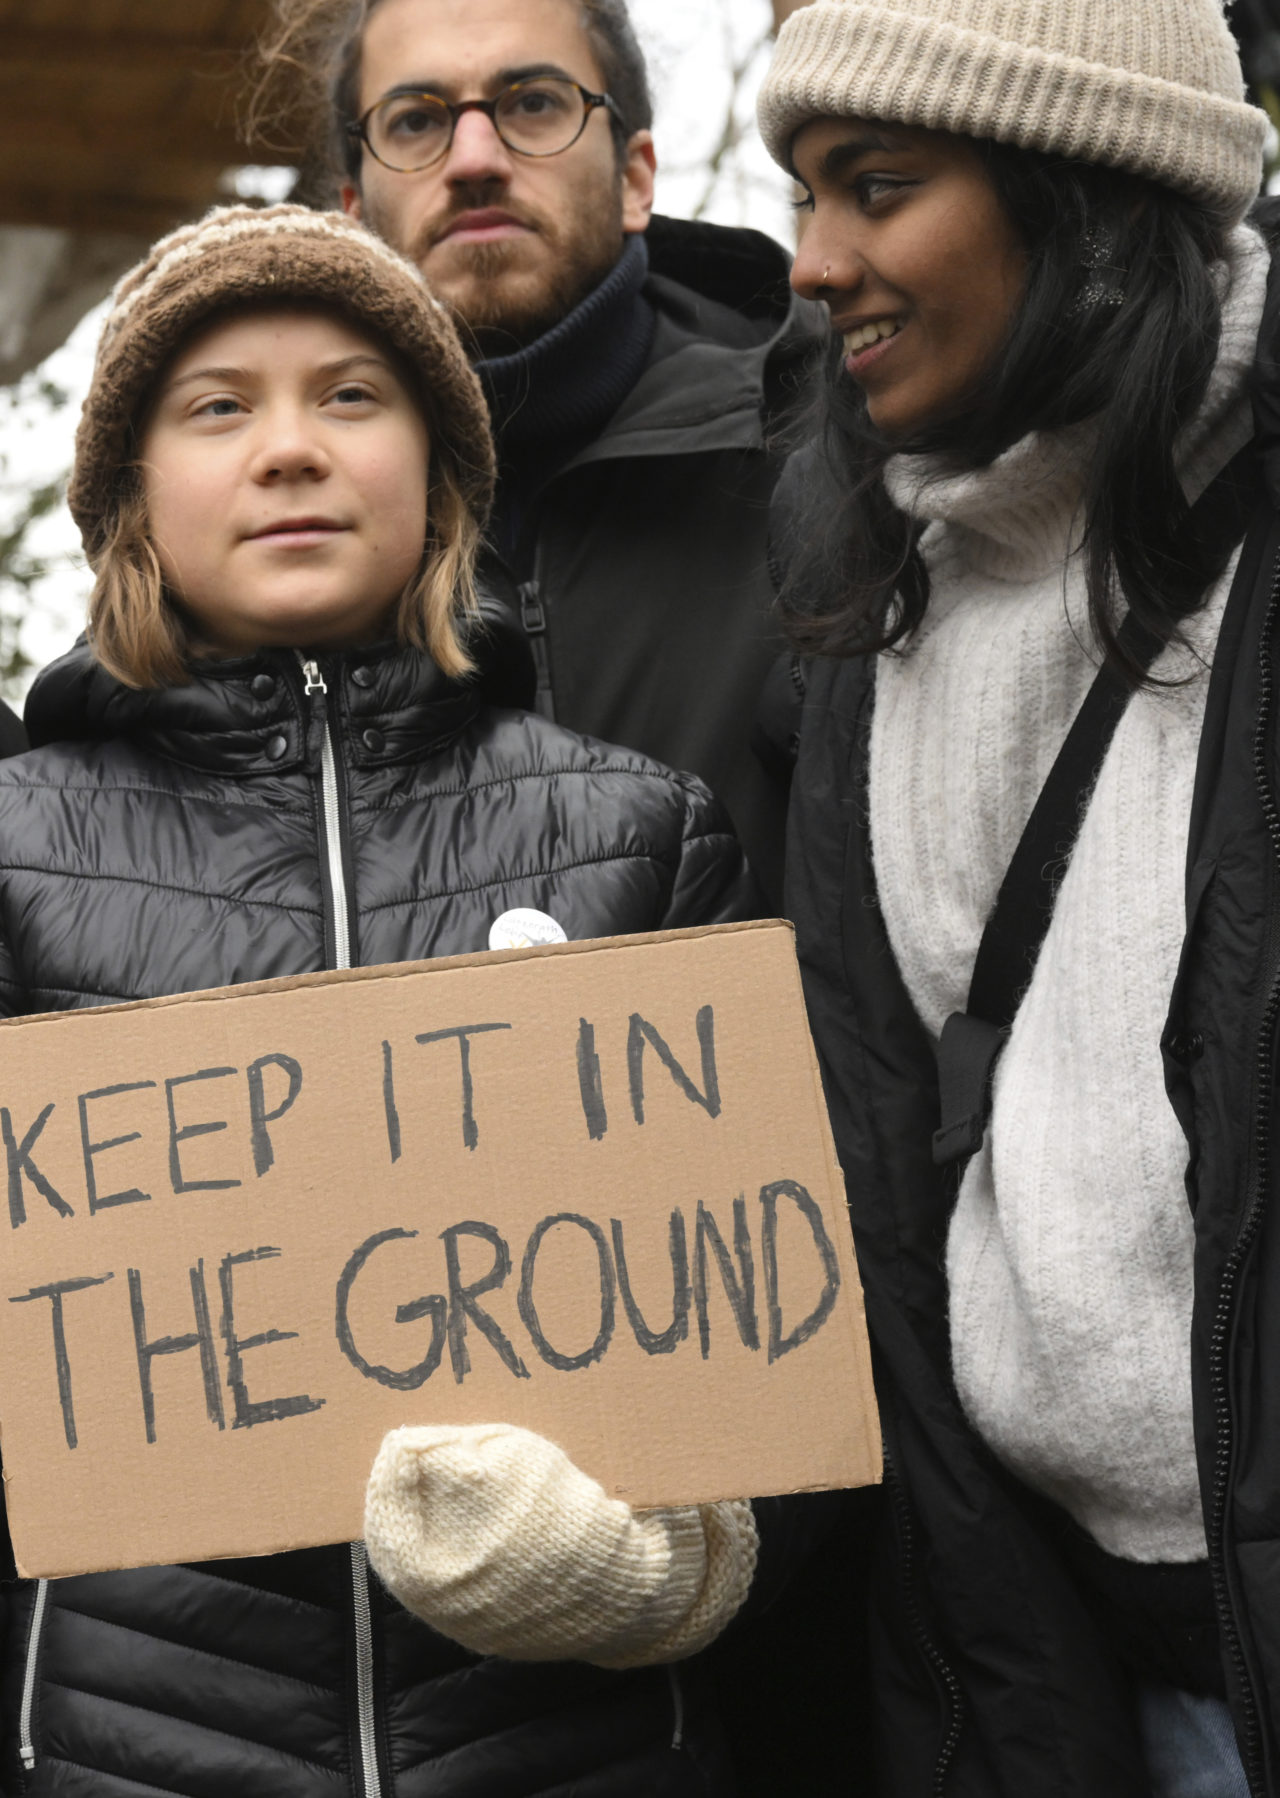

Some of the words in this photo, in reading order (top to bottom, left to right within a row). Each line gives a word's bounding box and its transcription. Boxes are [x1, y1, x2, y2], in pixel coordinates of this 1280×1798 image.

[0, 1052, 303, 1228] KEEP
[381, 1022, 512, 1163] IT
[578, 1004, 722, 1141] IN
[7, 1246, 326, 1449] THE
[335, 1179, 841, 1391] GROUND
